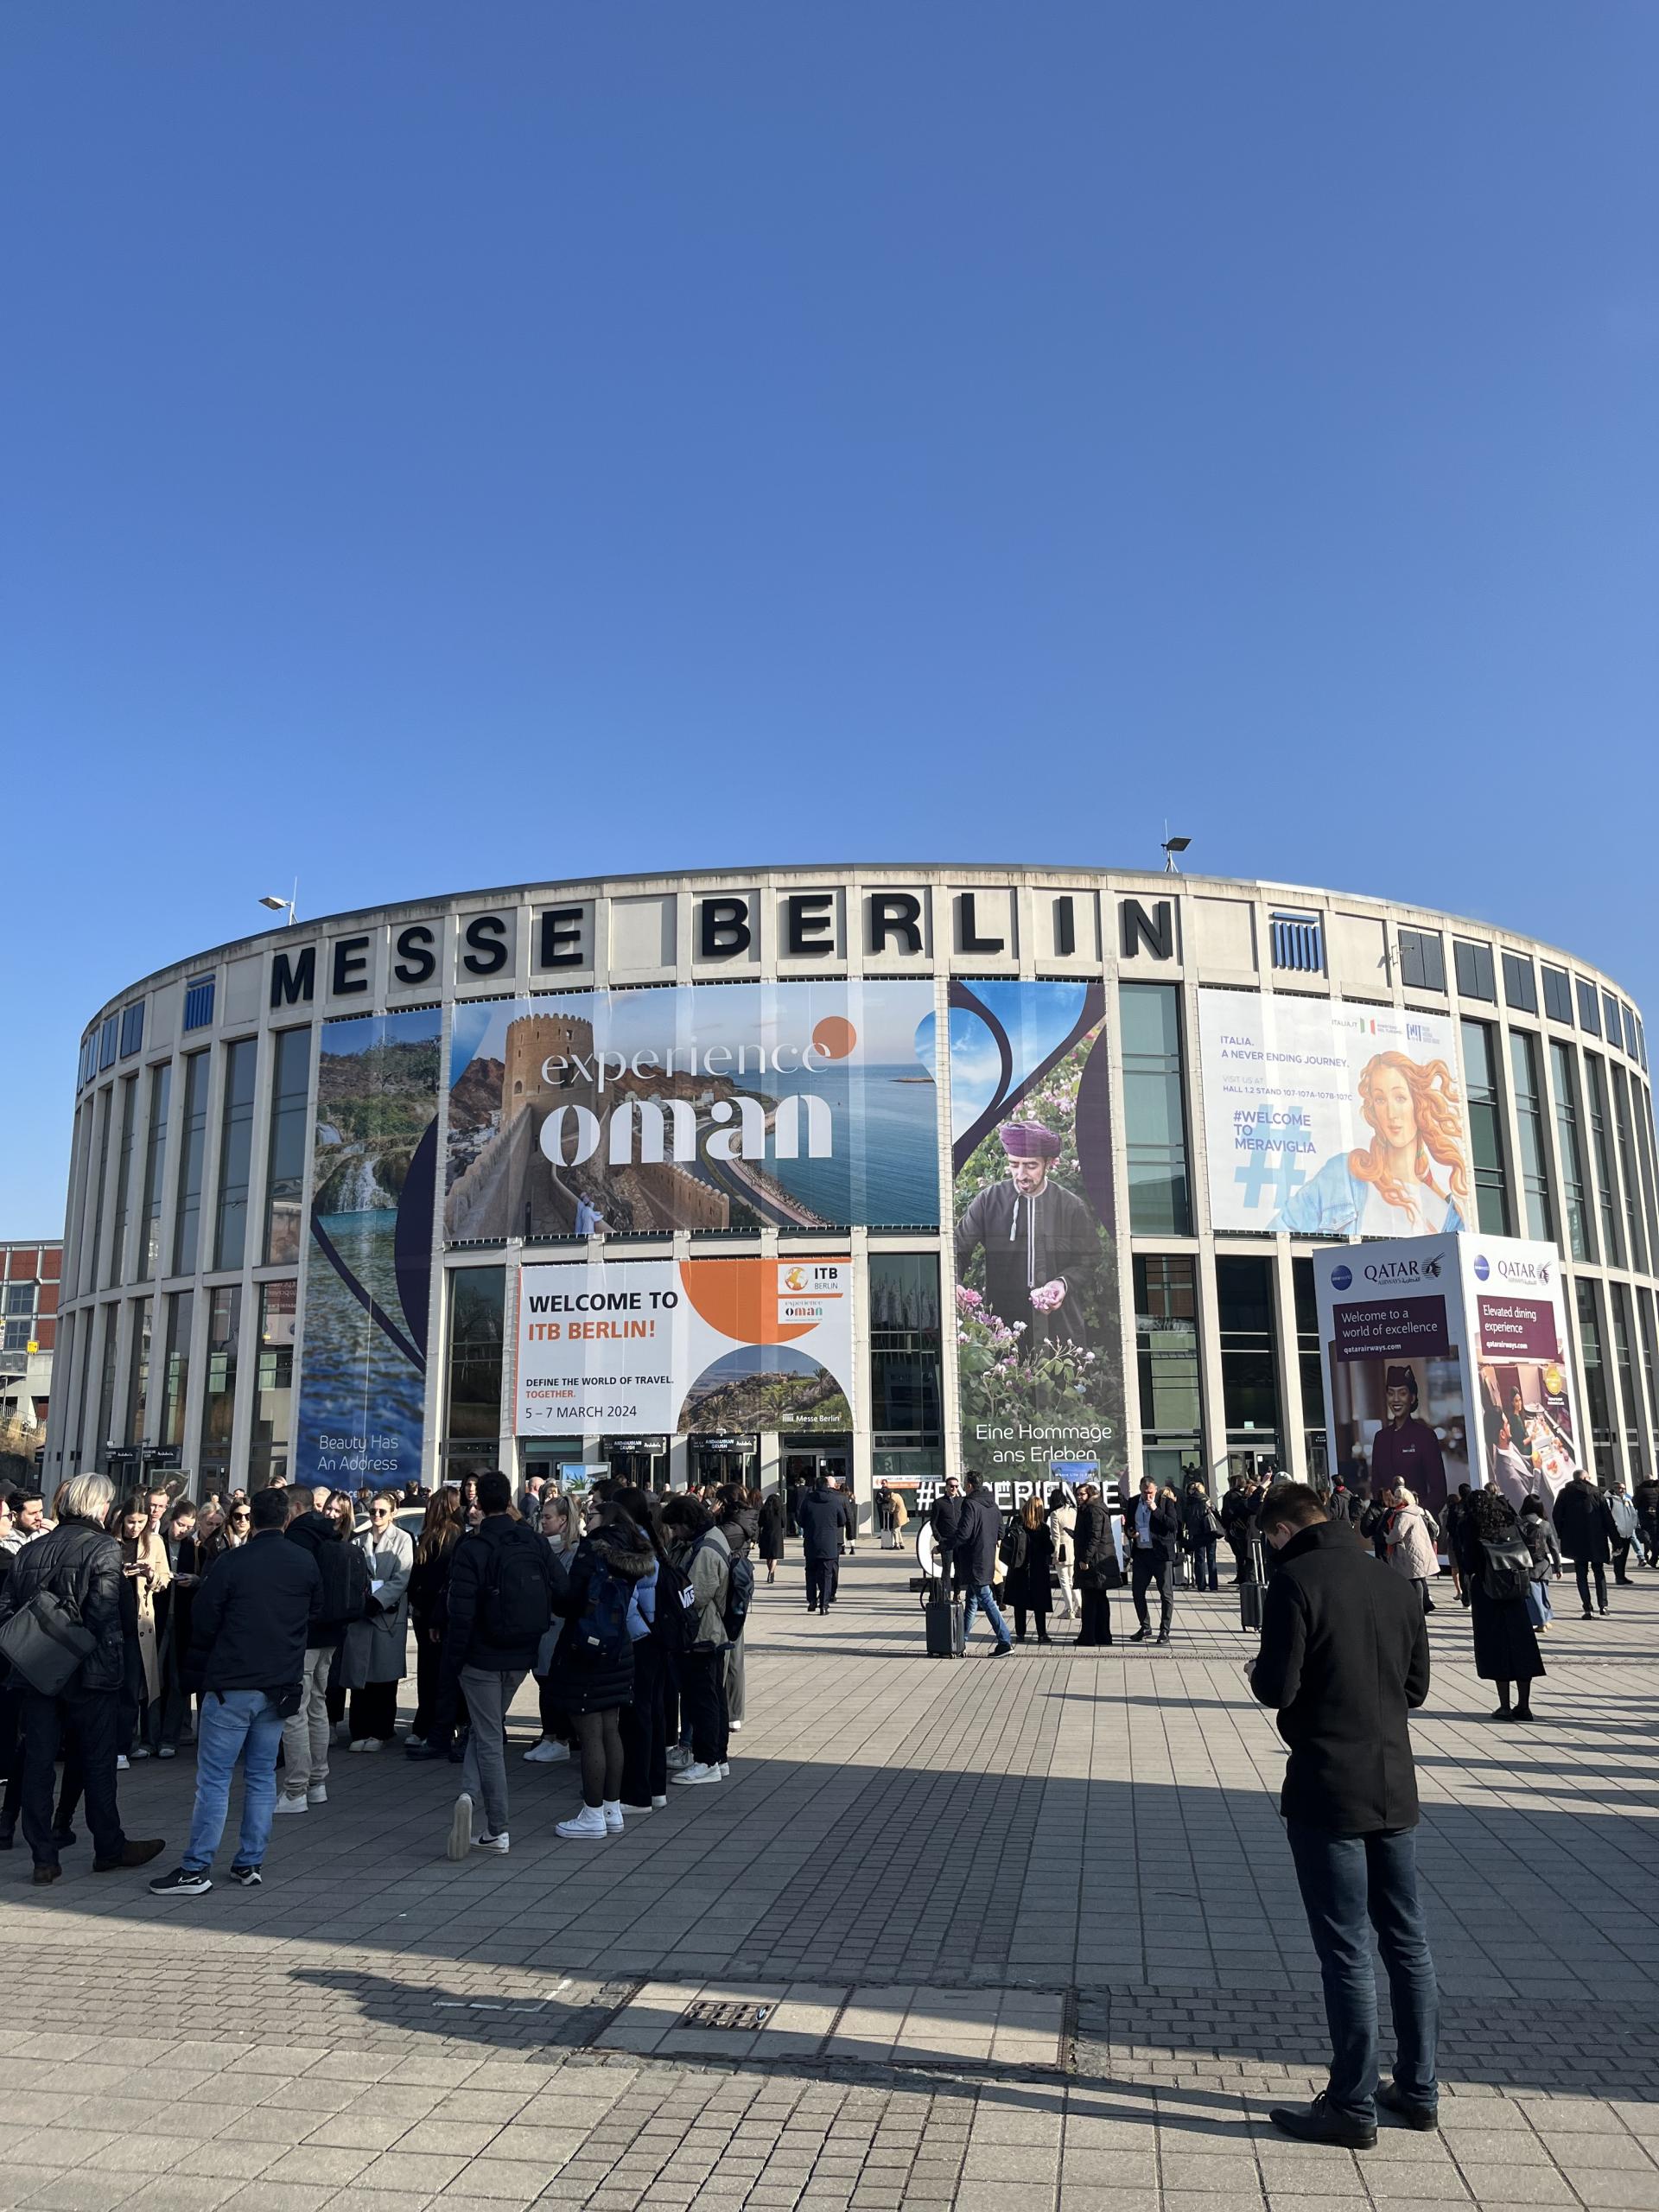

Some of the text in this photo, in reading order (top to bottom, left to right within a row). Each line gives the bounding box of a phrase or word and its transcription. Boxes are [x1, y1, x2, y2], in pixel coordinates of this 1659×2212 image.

[270, 893, 1173, 1008] MESSE BERLIN
[1220, 1035, 1255, 1046] ITALIA.
[541, 1034, 831, 1093] experience
[1221, 1049, 1350, 1068] A NEVER ENDING JOURNEY.
[1256, 1087, 1281, 1096] STAND
[1233, 1109, 1312, 1127] #WELCOME
[539, 1094, 832, 1166] oman
[1233, 1124, 1253, 1136] TO
[1235, 1137, 1317, 1154] MERAVIGLIA
[814, 1267, 838, 1280] ITB
[1363, 1260, 1420, 1283] QATAR
[1497, 1260, 1536, 1279] QATAR
[529, 1291, 678, 1313] WELCOME TO
[785, 1306, 823, 1316] oman
[1341, 1309, 1409, 1323] Welcome to a
[1482, 1304, 1537, 1322] Elevated dining
[528, 1319, 655, 1341] ITB BERLIN!
[1342, 1321, 1438, 1338] world of excellence
[1484, 1321, 1523, 1334] experience
[1344, 1343, 1402, 1355] qatarairways.com
[1486, 1340, 1529, 1351] qatarairways.com
[526, 1375, 674, 1387] DEFINE THE WORLD OF TRAVEL.
[525, 1389, 576, 1399] TOGETHER.
[525, 1408, 532, 1419] 5
[545, 1407, 553, 1419] 7
[556, 1406, 603, 1418] MARCH
[607, 1405, 637, 1417] 2024
[976, 1423, 1112, 1443] Eine Hommage
[319, 1434, 399, 1452] Beauty Has
[317, 1455, 398, 1471] An Address
[993, 1446, 1097, 1463] ans Erleben
